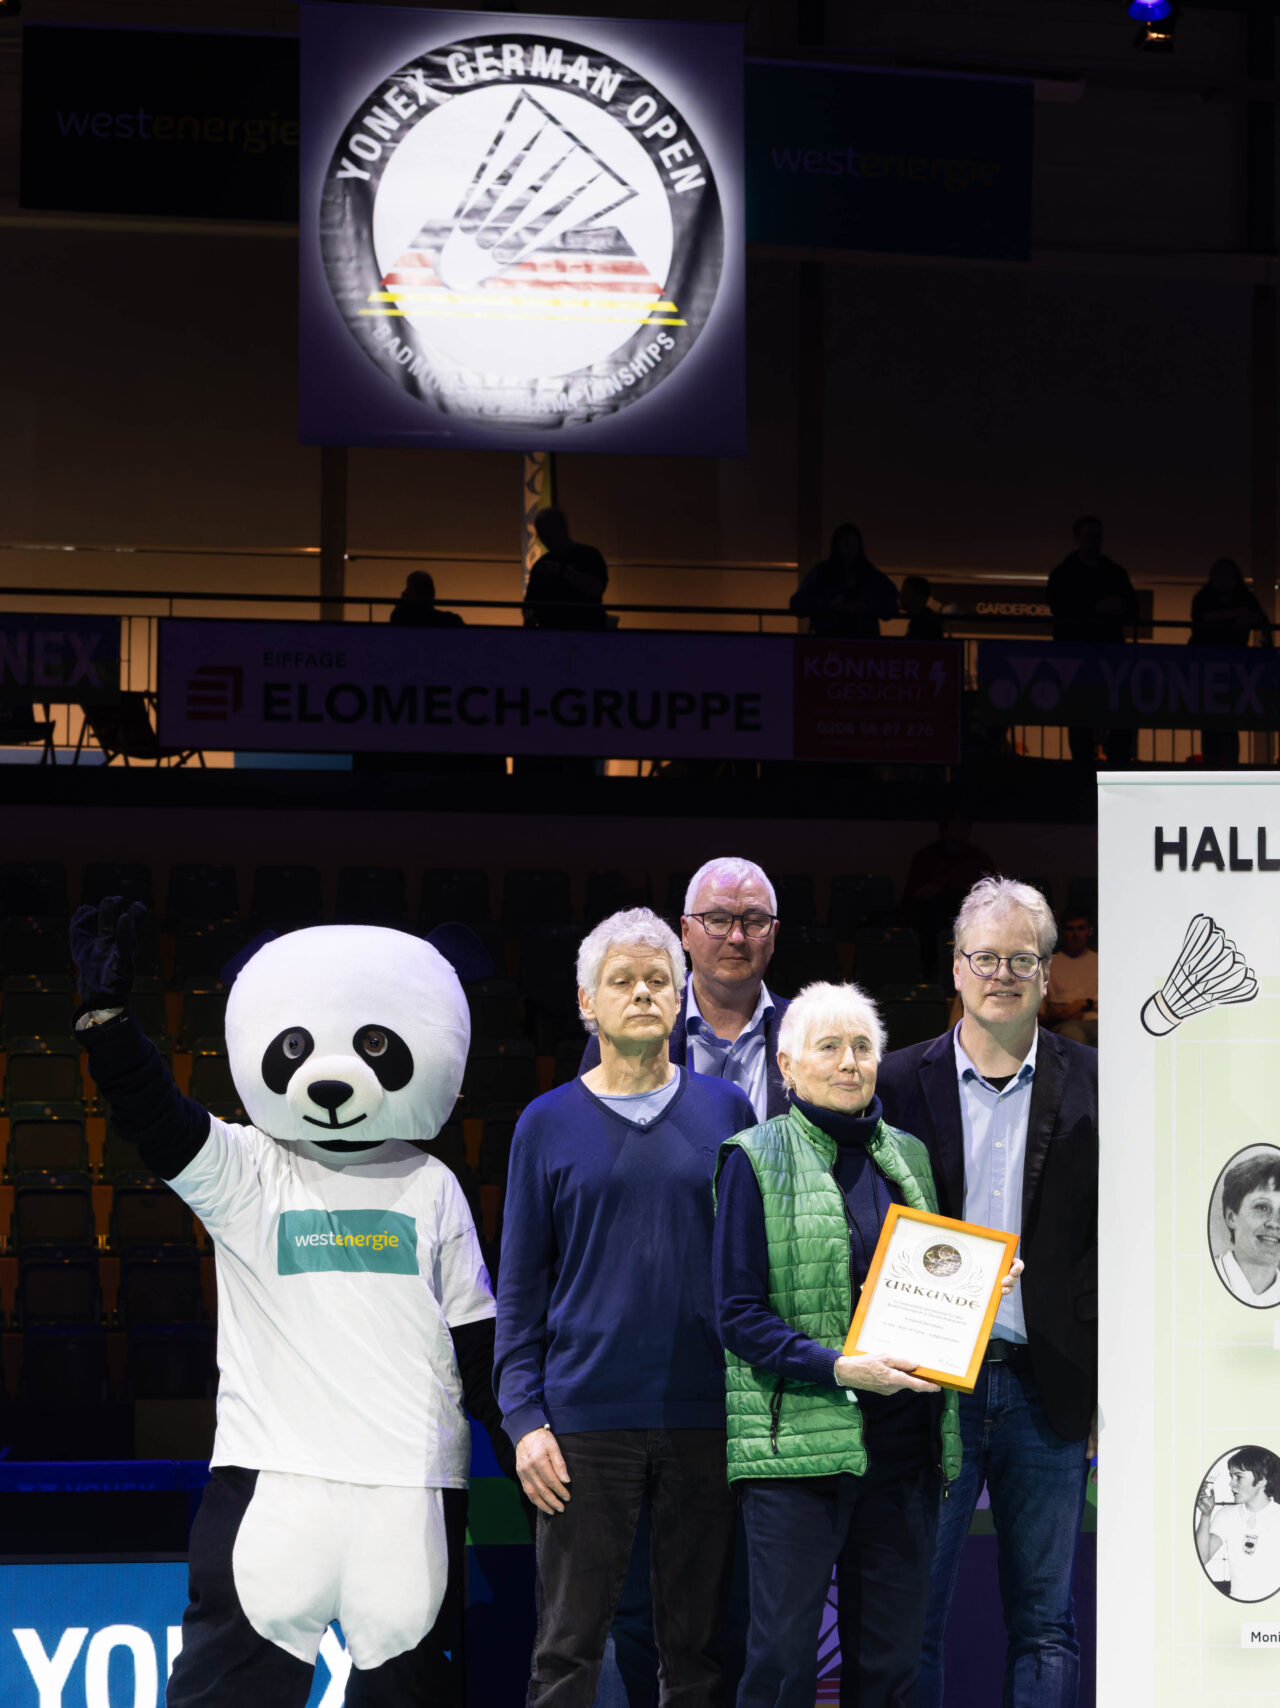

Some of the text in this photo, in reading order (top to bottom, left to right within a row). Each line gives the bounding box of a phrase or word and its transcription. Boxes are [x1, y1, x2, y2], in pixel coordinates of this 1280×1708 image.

[56, 104, 299, 154] westenergie
[335, 43, 706, 195] YONEX GERMAN OPEN
[770, 147, 1000, 192] westenergie
[263, 650, 347, 668] EIFFAGE
[803, 651, 921, 681] KÖNNER
[263, 682, 762, 732] ELOMECH-GRUPPE
[827, 682, 927, 703] GESUCHT
[1099, 660, 1265, 715] YONEX
[294, 1230, 399, 1251] westenergie
[883, 1277, 982, 1310] URKUNDE
